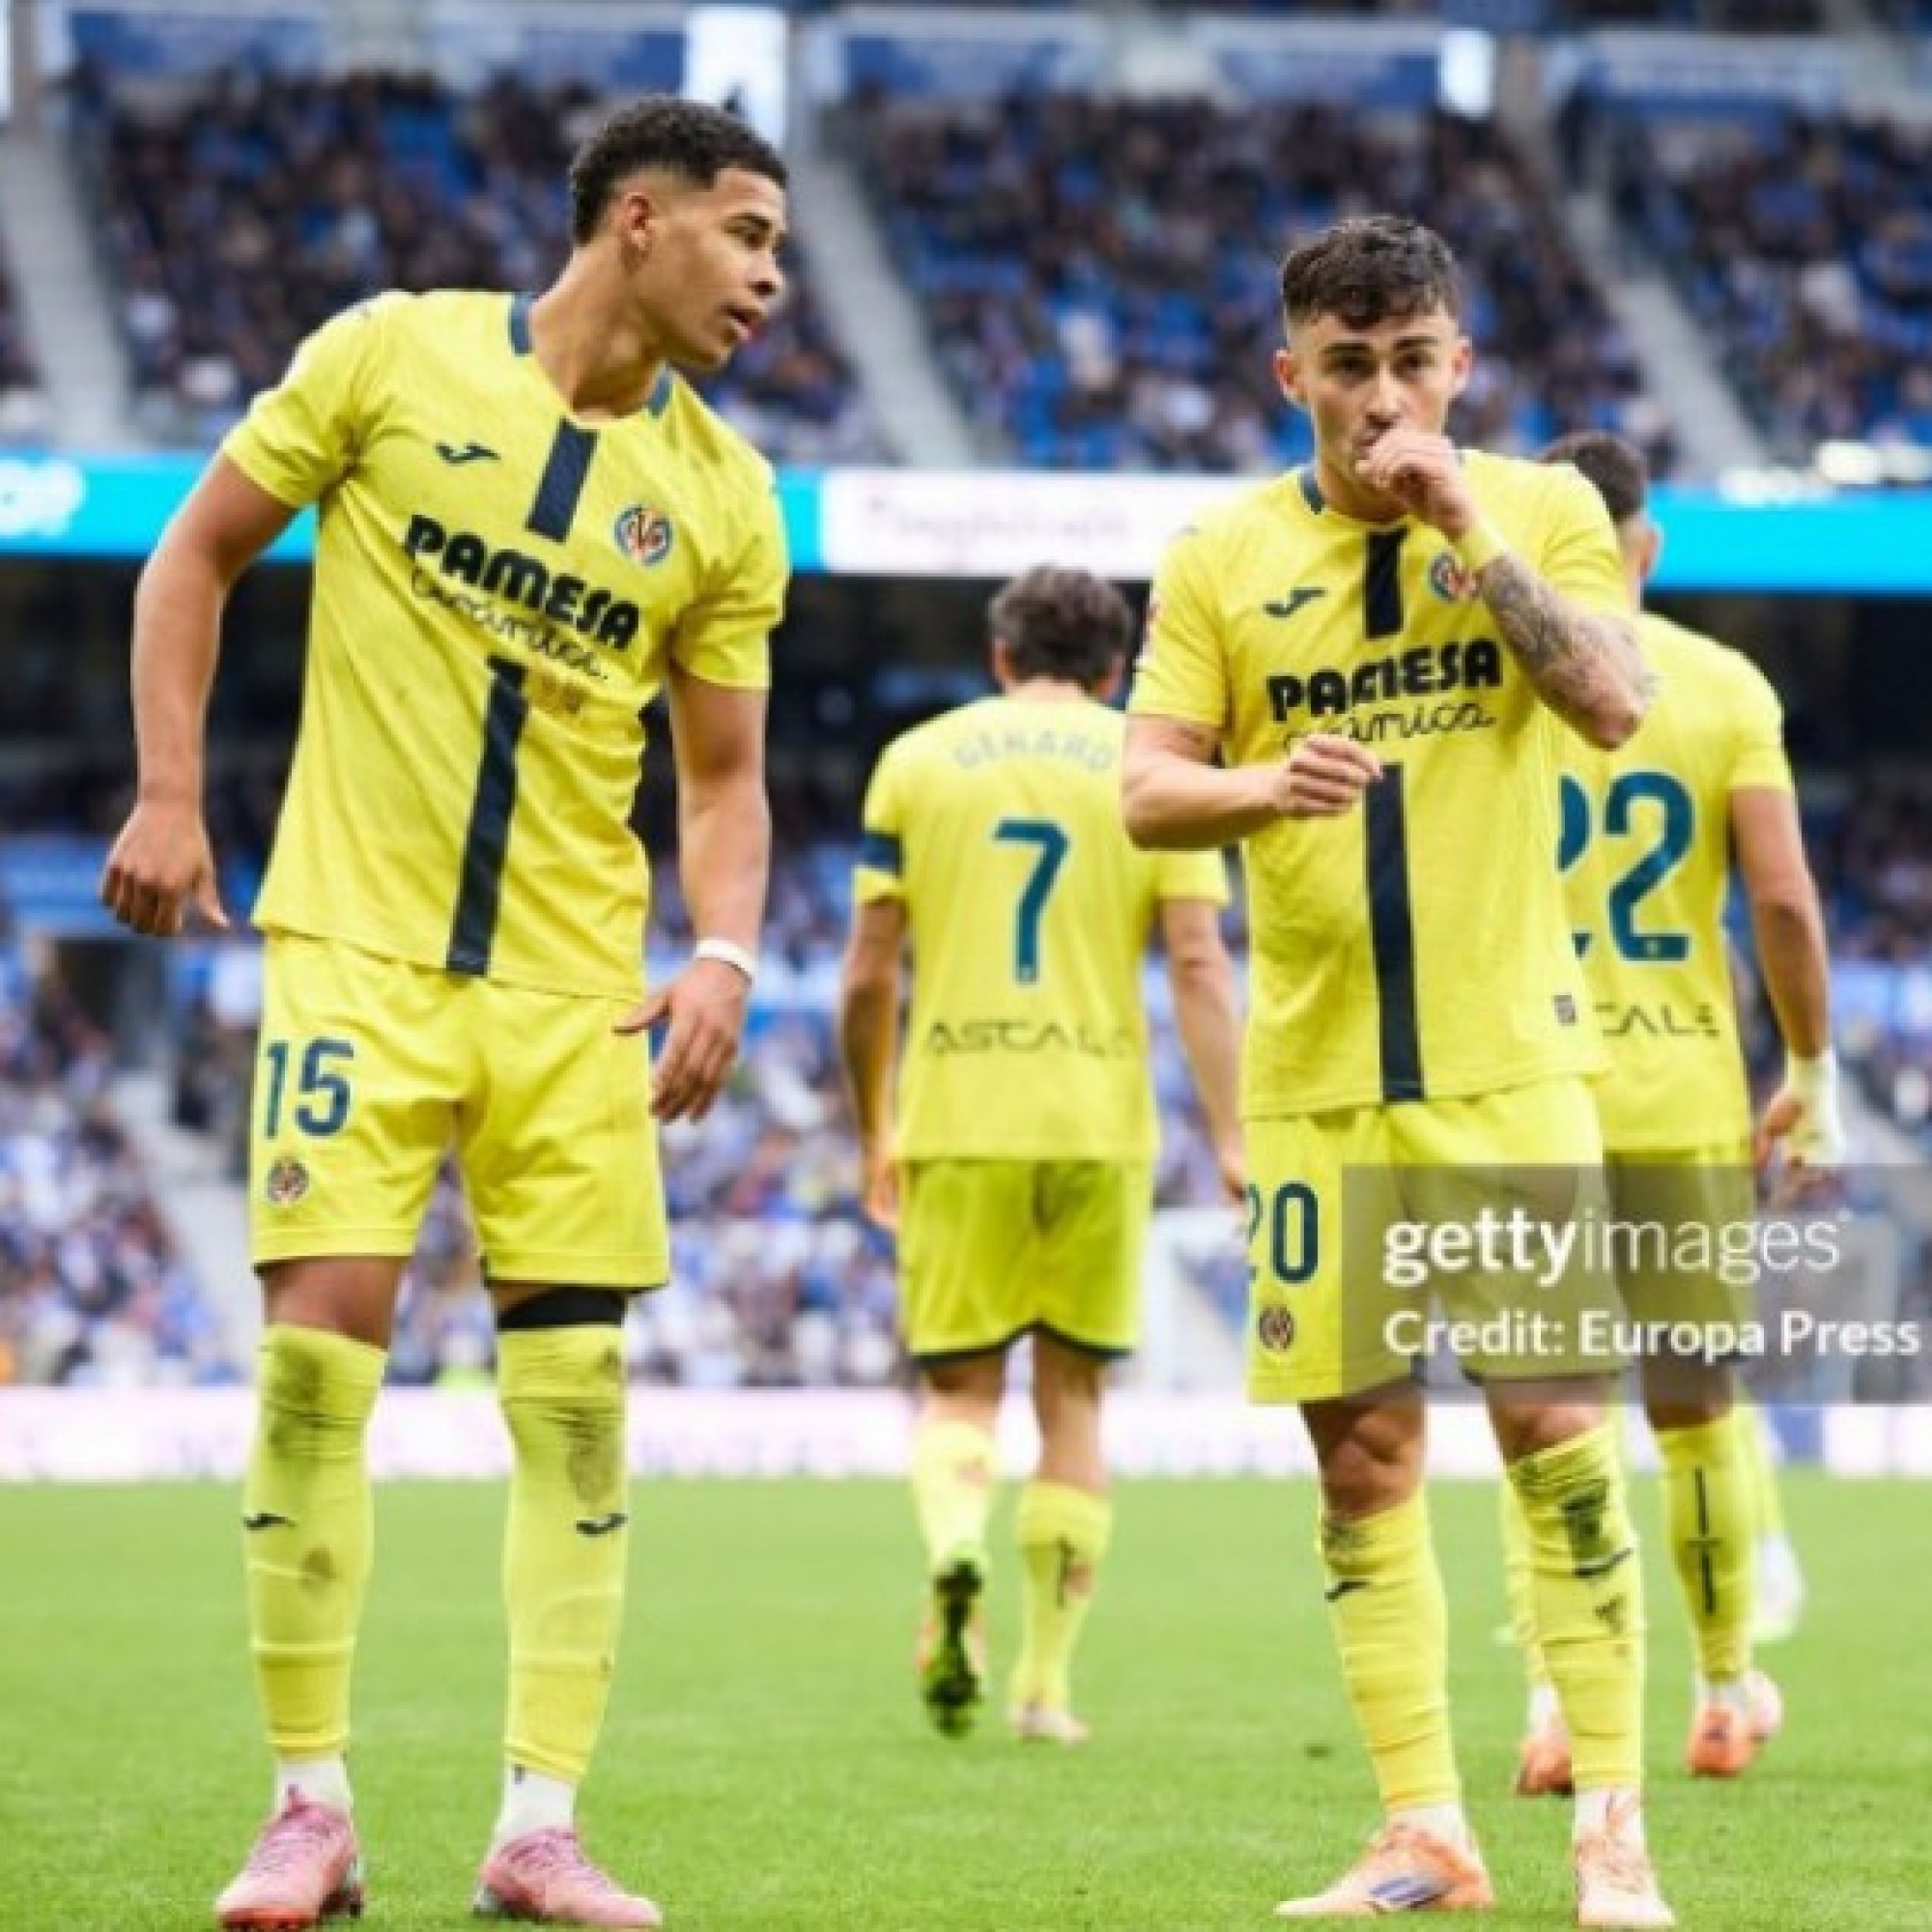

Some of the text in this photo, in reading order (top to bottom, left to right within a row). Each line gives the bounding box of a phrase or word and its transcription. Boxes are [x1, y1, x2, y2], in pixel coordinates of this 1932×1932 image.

[403, 514, 640, 653] PAMESA
[994, 818, 1070, 984] 7
[1592, 1002, 1720, 1037] CALE
[266, 1037, 355, 1140] 15
